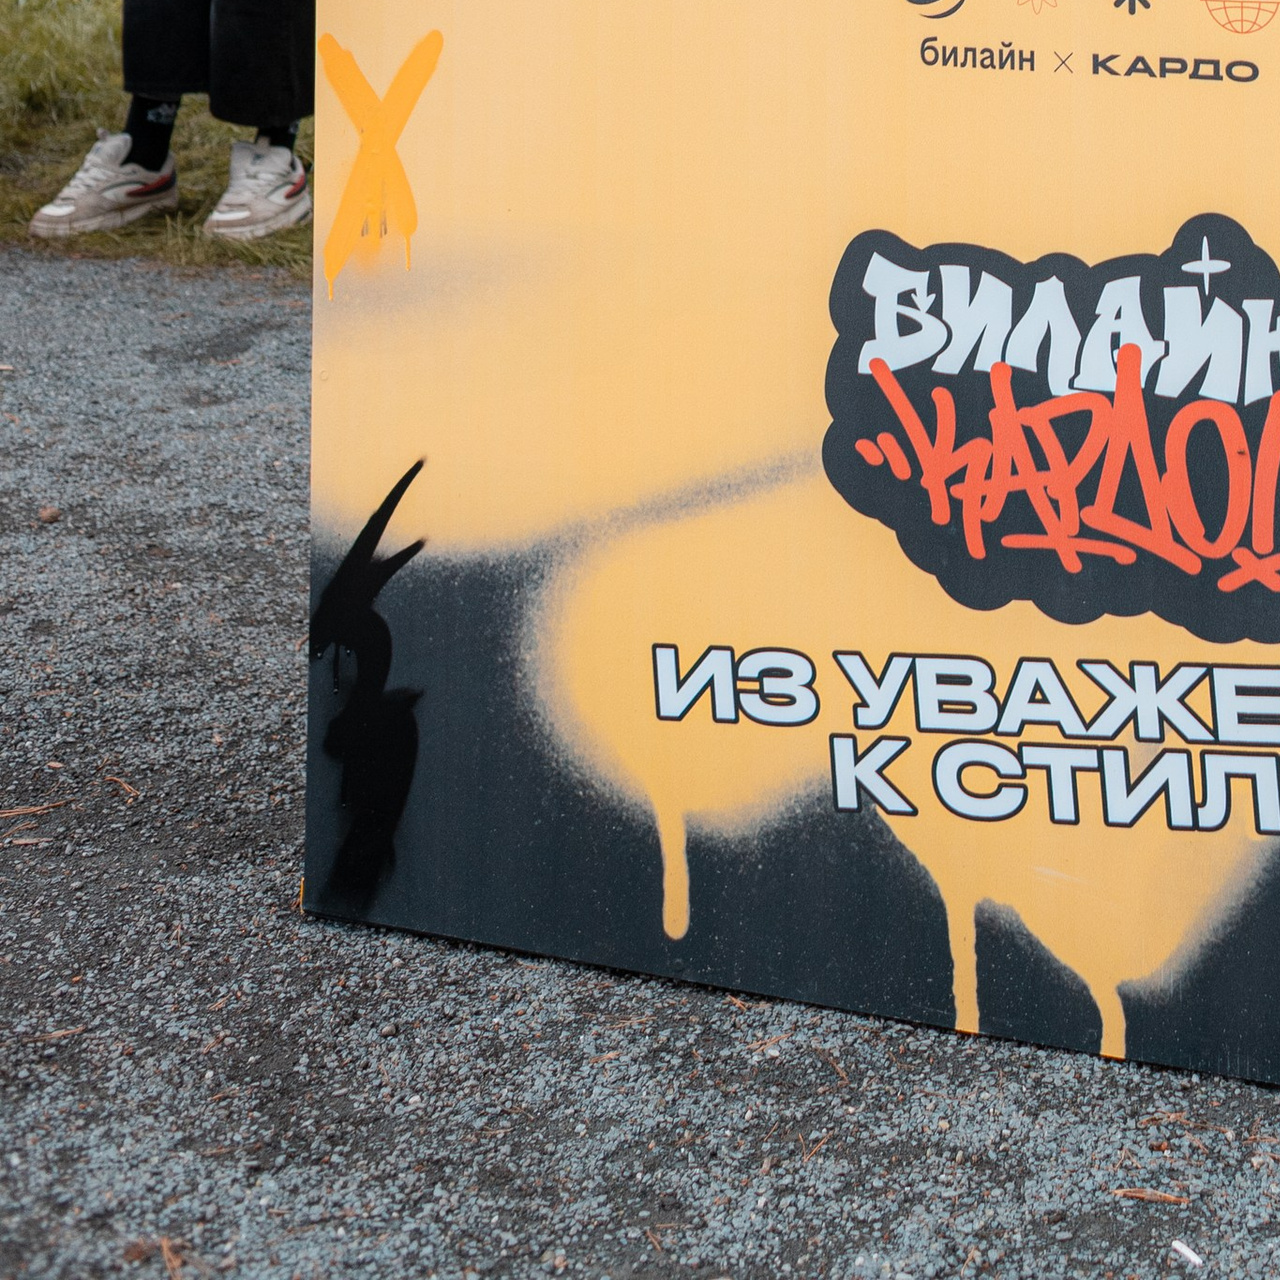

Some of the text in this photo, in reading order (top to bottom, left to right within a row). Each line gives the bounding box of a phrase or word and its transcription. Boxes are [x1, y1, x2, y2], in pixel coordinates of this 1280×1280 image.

[920, 36, 1035, 71] билайн
[1092, 53, 1260, 82] КАРДО
[652, 642, 822, 727] ИЗ
[829, 732, 917, 816] К
